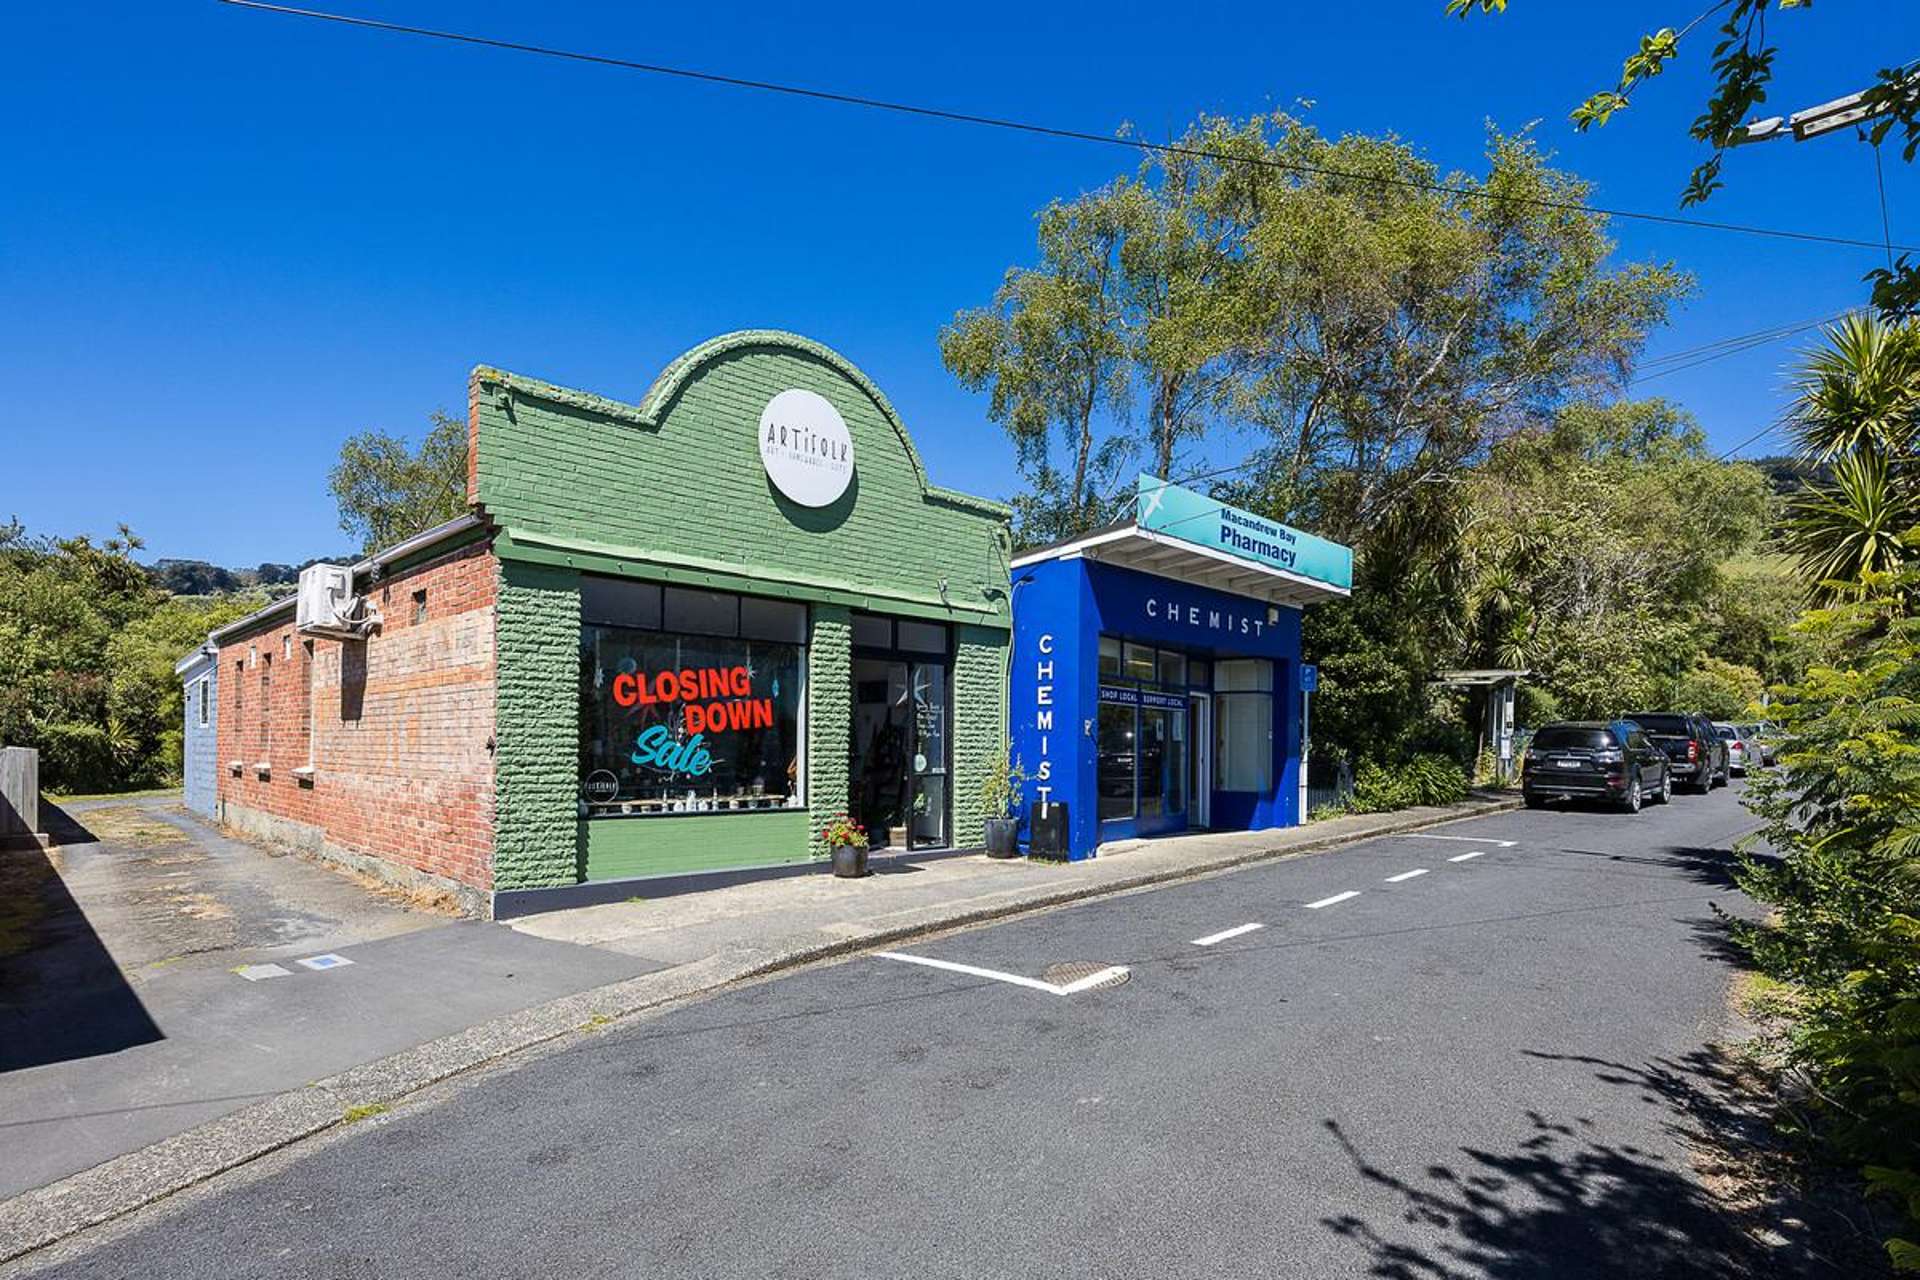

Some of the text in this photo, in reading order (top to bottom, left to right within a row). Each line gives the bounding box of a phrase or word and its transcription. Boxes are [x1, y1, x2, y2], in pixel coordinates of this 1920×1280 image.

[1221, 508, 1297, 546] Macandrew Bay
[1221, 524, 1297, 568] Pharmacy
[1146, 598, 1264, 638] CHEMIST
[613, 666, 750, 706] CLOSING
[1119, 691, 1138, 702] LOCAL
[684, 698, 774, 737] DOWN
[1036, 634, 1054, 804] CHEMIST
[631, 724, 713, 776] Sale
